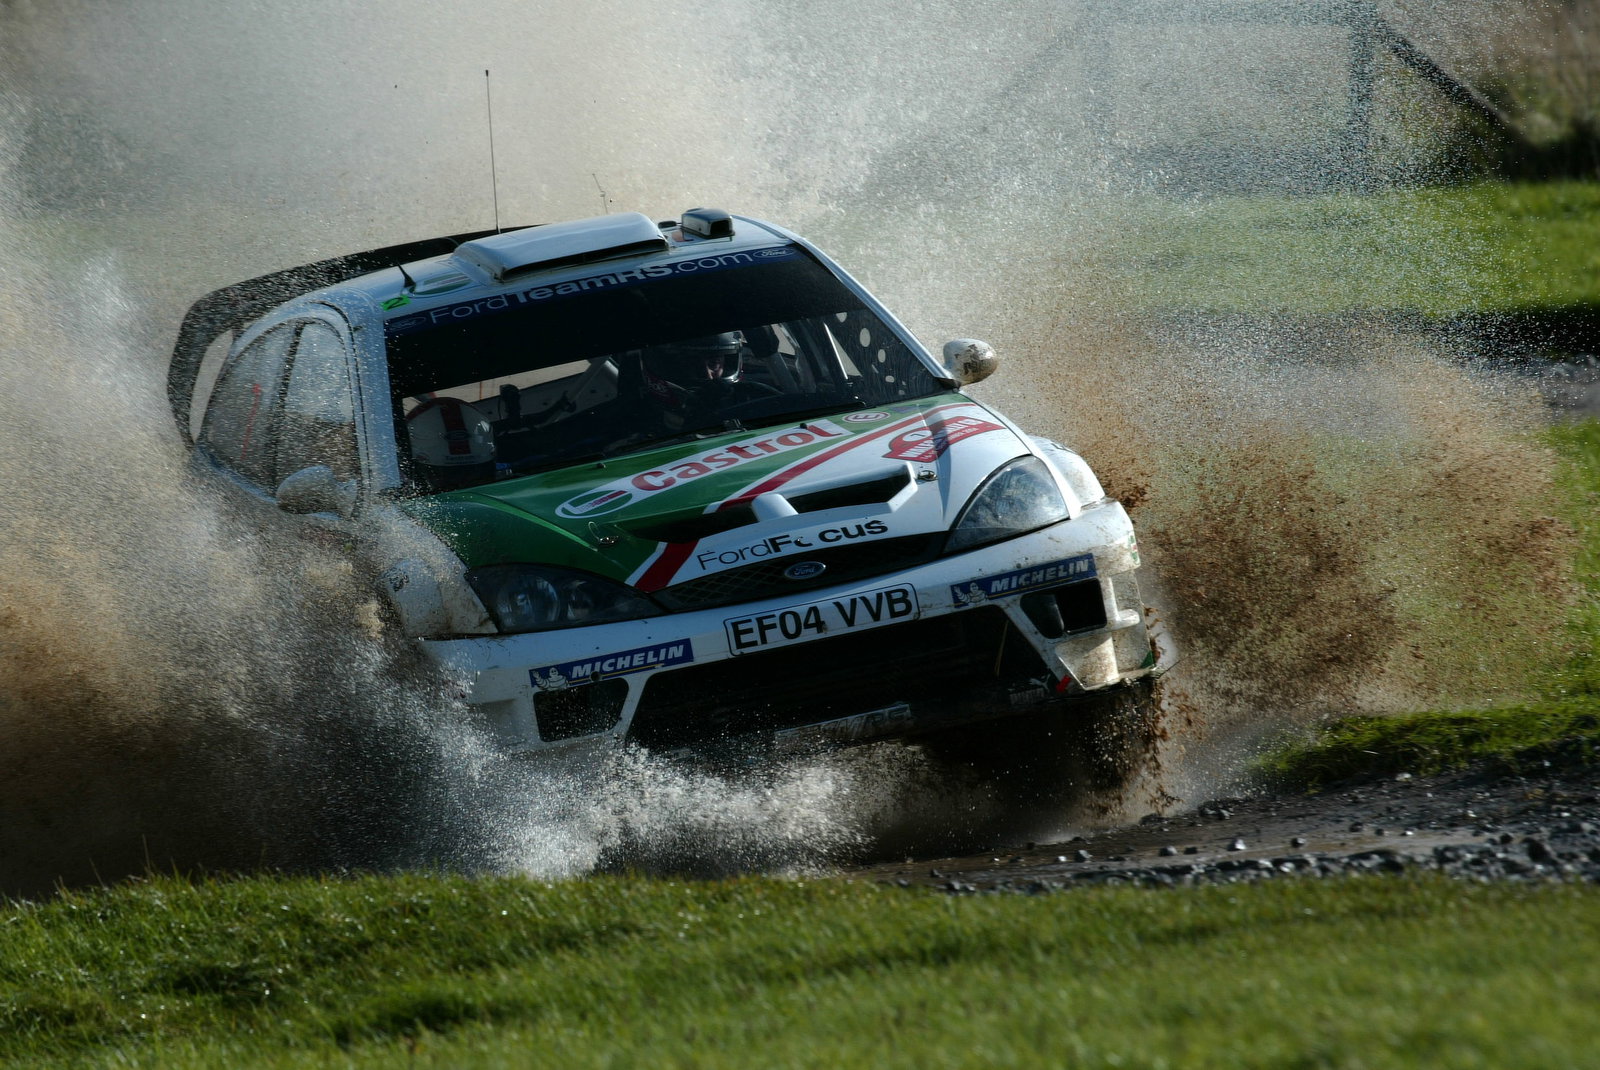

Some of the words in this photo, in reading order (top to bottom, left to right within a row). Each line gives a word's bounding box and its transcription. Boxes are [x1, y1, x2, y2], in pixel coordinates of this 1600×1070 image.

[430, 251, 753, 323] FordTeamRS.com
[631, 424, 843, 491] Castrol
[990, 559, 1089, 593] MICHELIN
[730, 605, 825, 650] EF04
[832, 588, 913, 627] VVB
[572, 644, 684, 678] MICHELIN
